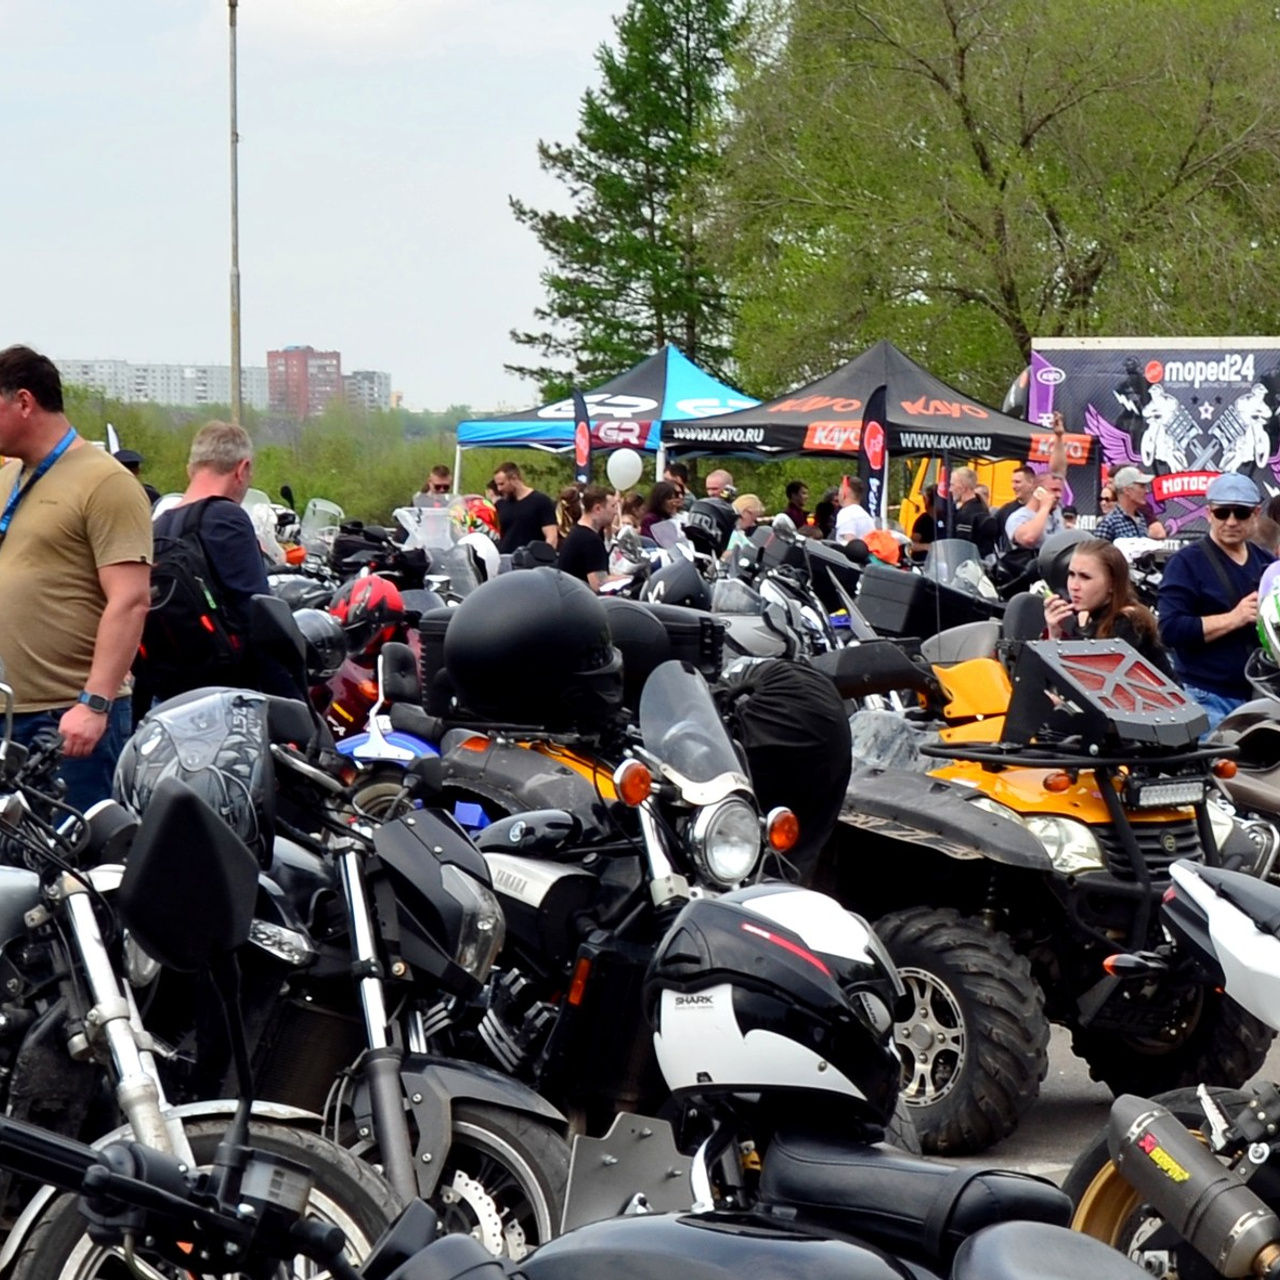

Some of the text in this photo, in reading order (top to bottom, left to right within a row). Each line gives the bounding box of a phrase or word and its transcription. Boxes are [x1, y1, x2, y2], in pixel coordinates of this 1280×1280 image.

[1164, 354, 1254, 389] moped24
[598, 421, 640, 444] GR
[673, 427, 765, 443] WWW.KAYO.RU
[899, 432, 992, 452] WWW.KAYO.RU
[675, 995, 714, 1005] SHARK
